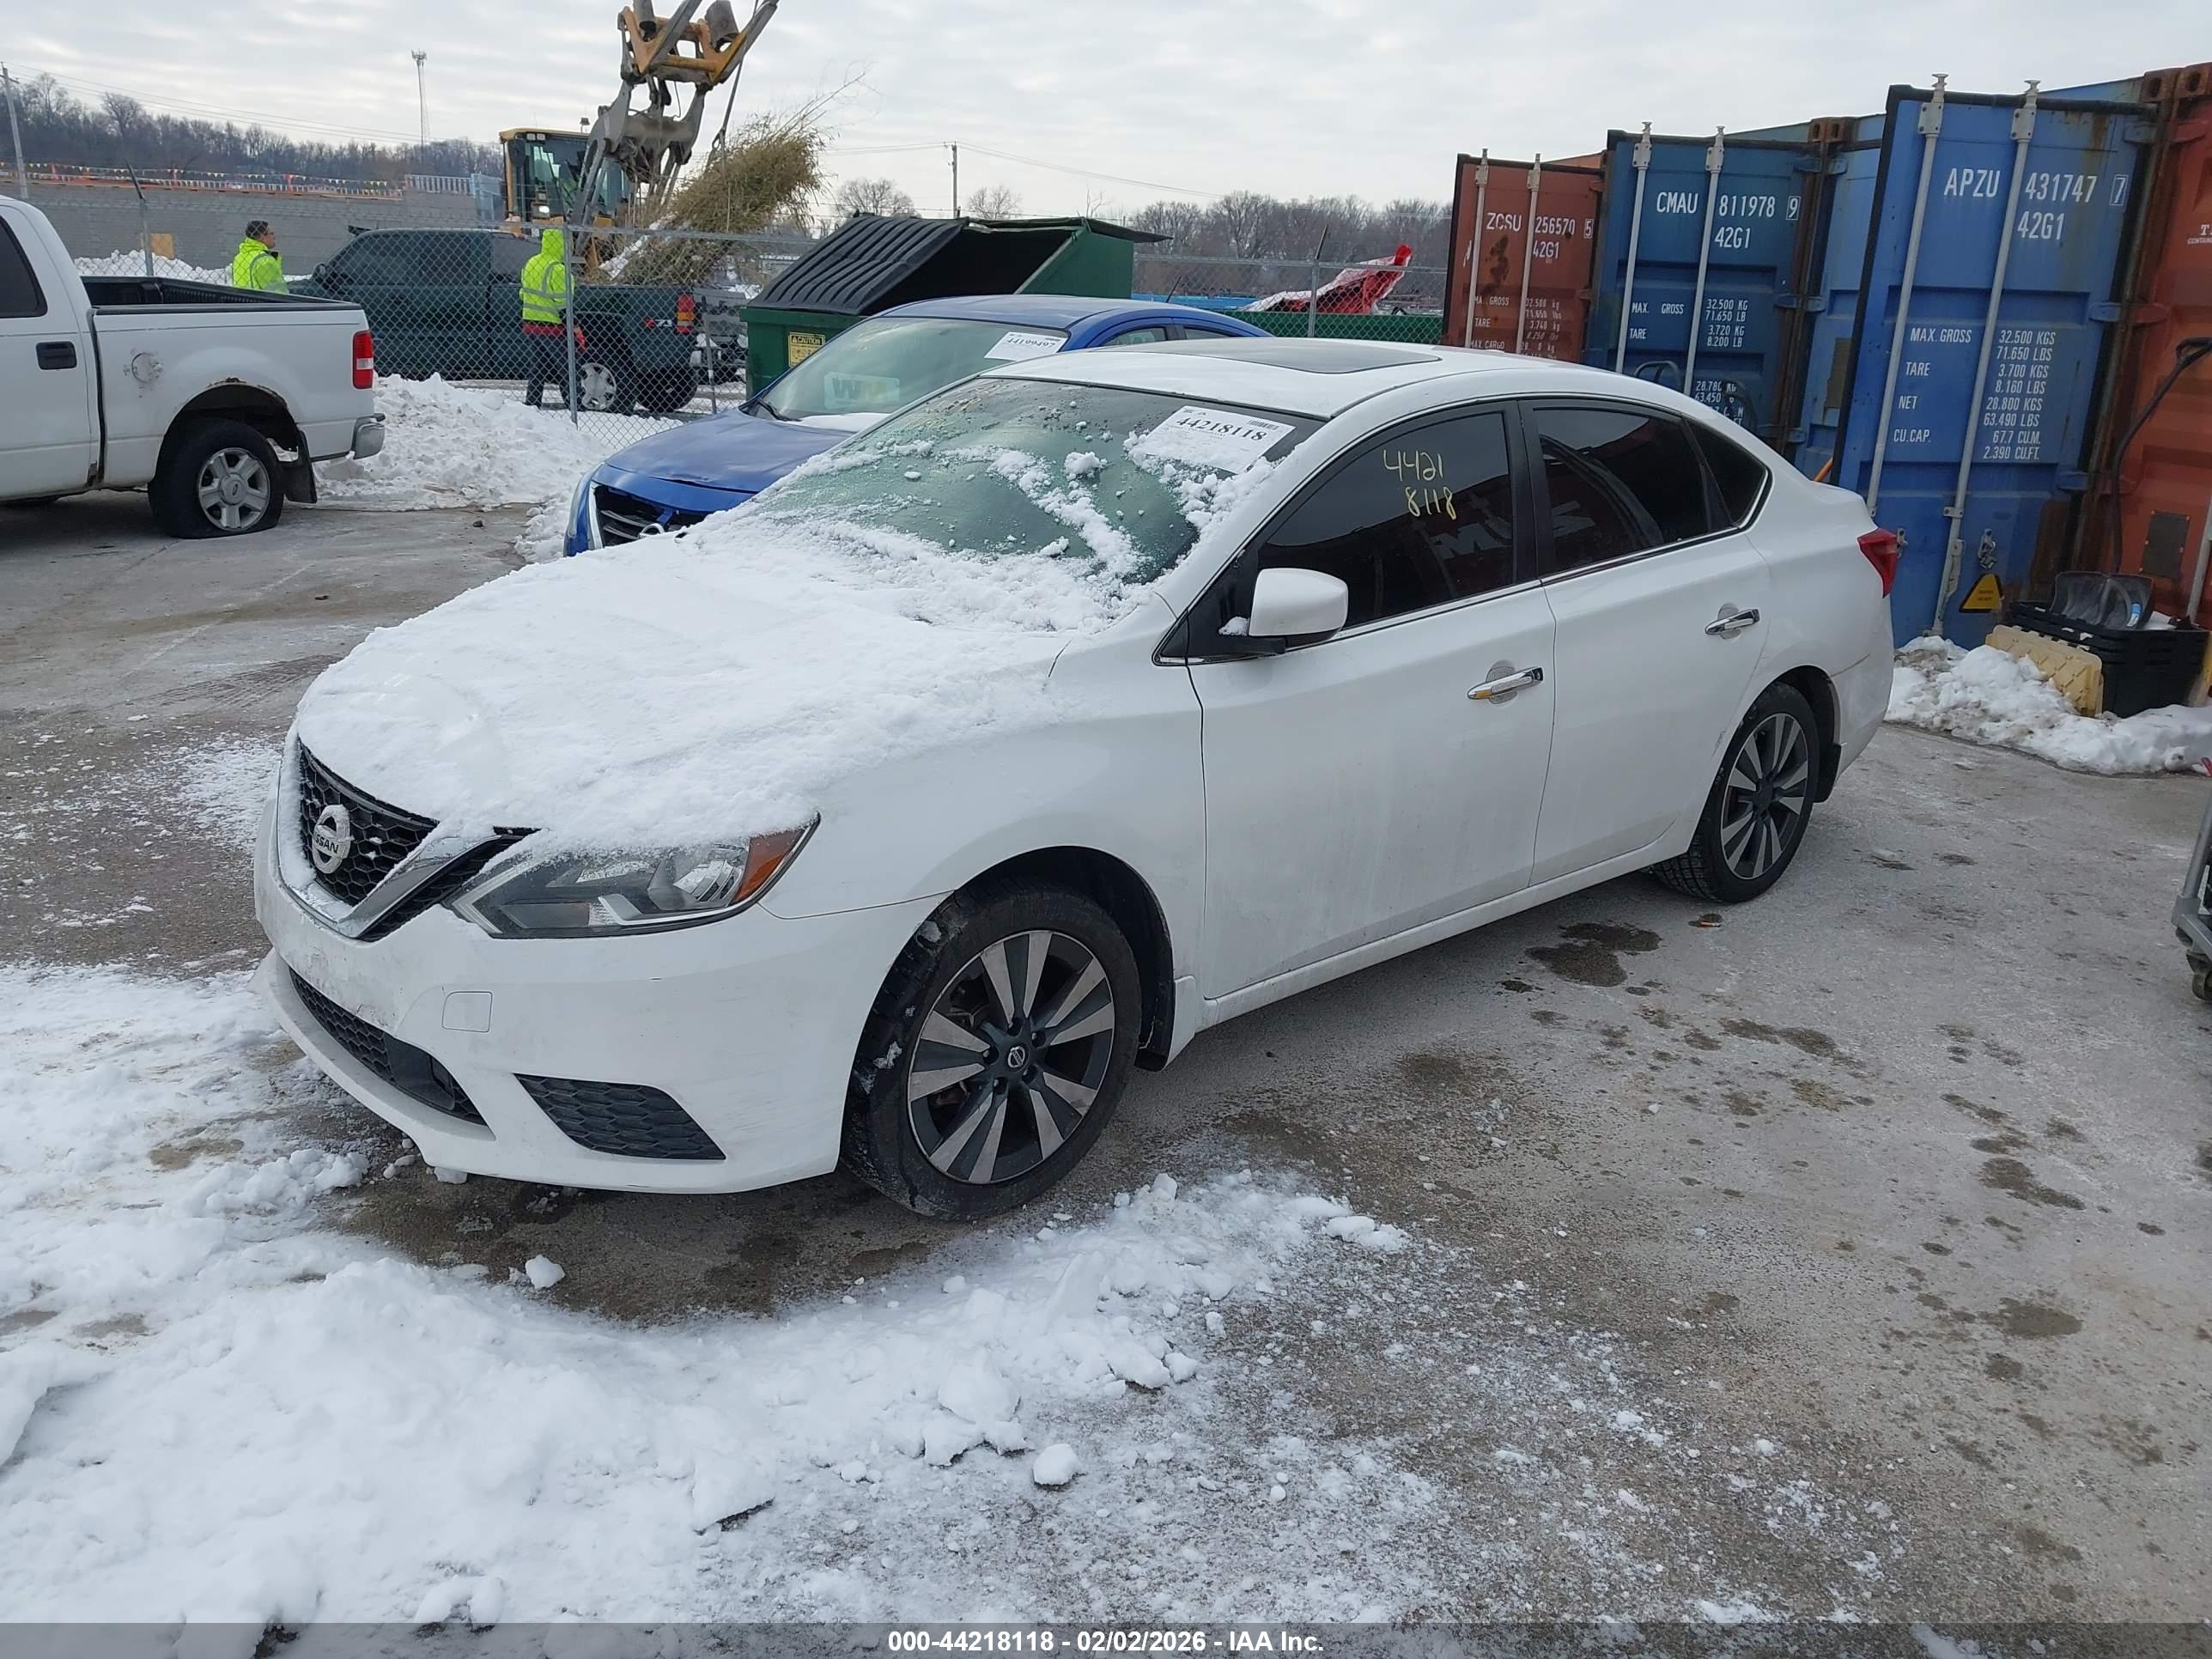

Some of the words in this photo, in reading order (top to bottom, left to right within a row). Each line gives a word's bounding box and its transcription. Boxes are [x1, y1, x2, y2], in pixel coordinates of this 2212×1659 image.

[1944, 168, 2001, 198] APZU
[2025, 173, 2097, 203] 431747
[2113, 176, 2127, 204] 7
[1656, 191, 1698, 214] CMAU
[1719, 195, 1775, 217] 811978
[1788, 197, 1799, 219] 9
[1486, 213, 1522, 232] ZCSU
[1534, 216, 1575, 236] 256570
[1584, 219, 1593, 238] 5
[2017, 211, 2064, 240] 42G1
[1715, 227, 1751, 249] 42G1
[1533, 241, 1559, 259] 42G1
[1489, 297, 1510, 307] GROSS
[1632, 302, 1649, 314] MAX.
[1661, 303, 1684, 314] GROSS
[1706, 299, 1734, 310] 32.500
[1738, 301, 1748, 310] KG
[1475, 318, 1491, 328] TARE
[1705, 311, 1732, 321] 71.650
[1736, 312, 1746, 322] LB
[1630, 328, 1647, 339] TARE
[1709, 325, 1730, 336] 3.720
[1735, 325, 1745, 336] KG
[1910, 328, 1937, 343] MAX.
[1940, 329, 1972, 343] GROSS
[1999, 331, 2033, 343] 32.500
[2036, 332, 2056, 345] KGS
[1707, 337, 1729, 347] 8.200
[1733, 337, 1742, 348] LB
[1996, 346, 2029, 360] 71.650
[2033, 348, 2052, 362] LBS
[1905, 362, 1930, 376] TARE
[1998, 364, 2026, 378] 3.700
[2030, 365, 2049, 379] KGS
[1995, 380, 2023, 393] 8.160
[2027, 380, 2046, 395] LBS
[1899, 396, 1918, 410] NET
[1986, 398, 2020, 411] 28.800
[2023, 398, 2043, 411] KGS
[1984, 413, 2016, 427] 63.490
[2020, 414, 2039, 427] LBS
[1176, 417, 1267, 441] 44218118
[1992, 430, 2014, 444] 67.7
[1983, 446, 2010, 459] 2.390
[1383, 449, 1443, 482] 4421
[1405, 486, 1456, 520] 8118
[315, 834, 339, 854] SSAN
